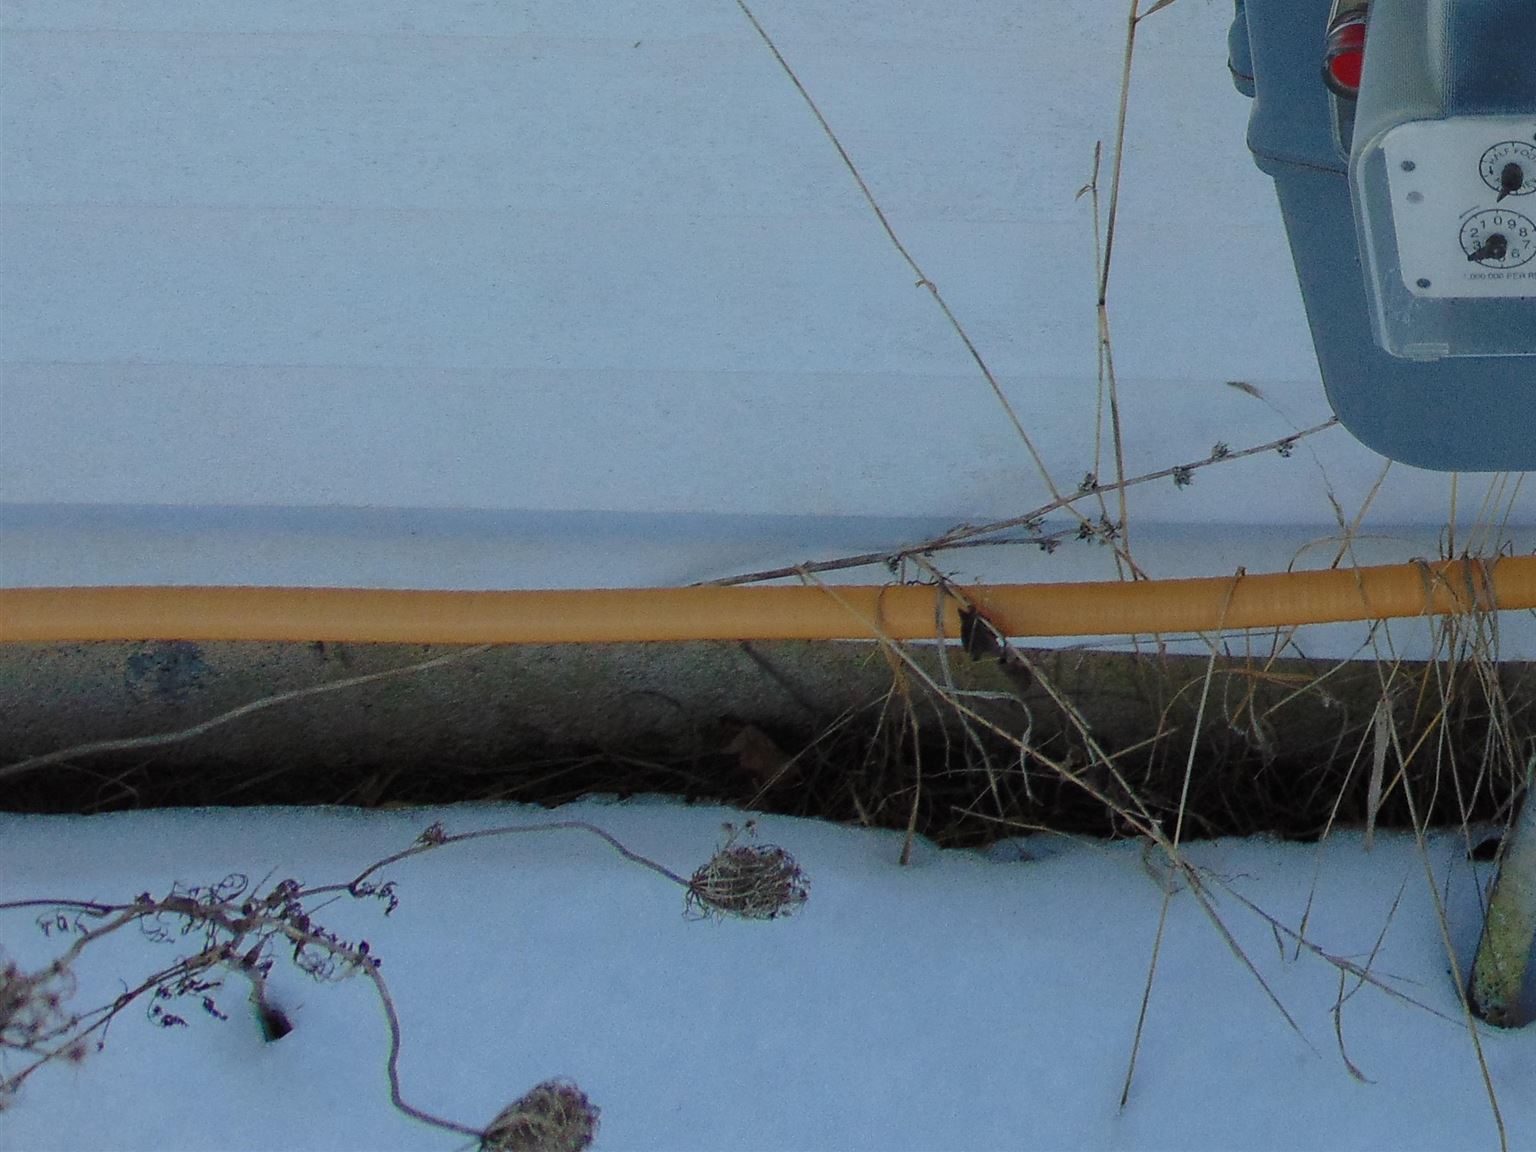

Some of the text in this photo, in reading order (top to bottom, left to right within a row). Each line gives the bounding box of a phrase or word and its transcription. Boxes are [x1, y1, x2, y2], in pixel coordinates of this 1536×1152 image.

[1494, 216, 1502, 225] 0
[1507, 219, 1516, 229] 9
[1471, 228, 1479, 238] 2
[1519, 228, 1528, 237] 8
[1522, 240, 1530, 249] 7
[1511, 248, 1520, 258] 6
[1506, 272, 1526, 280] PER
